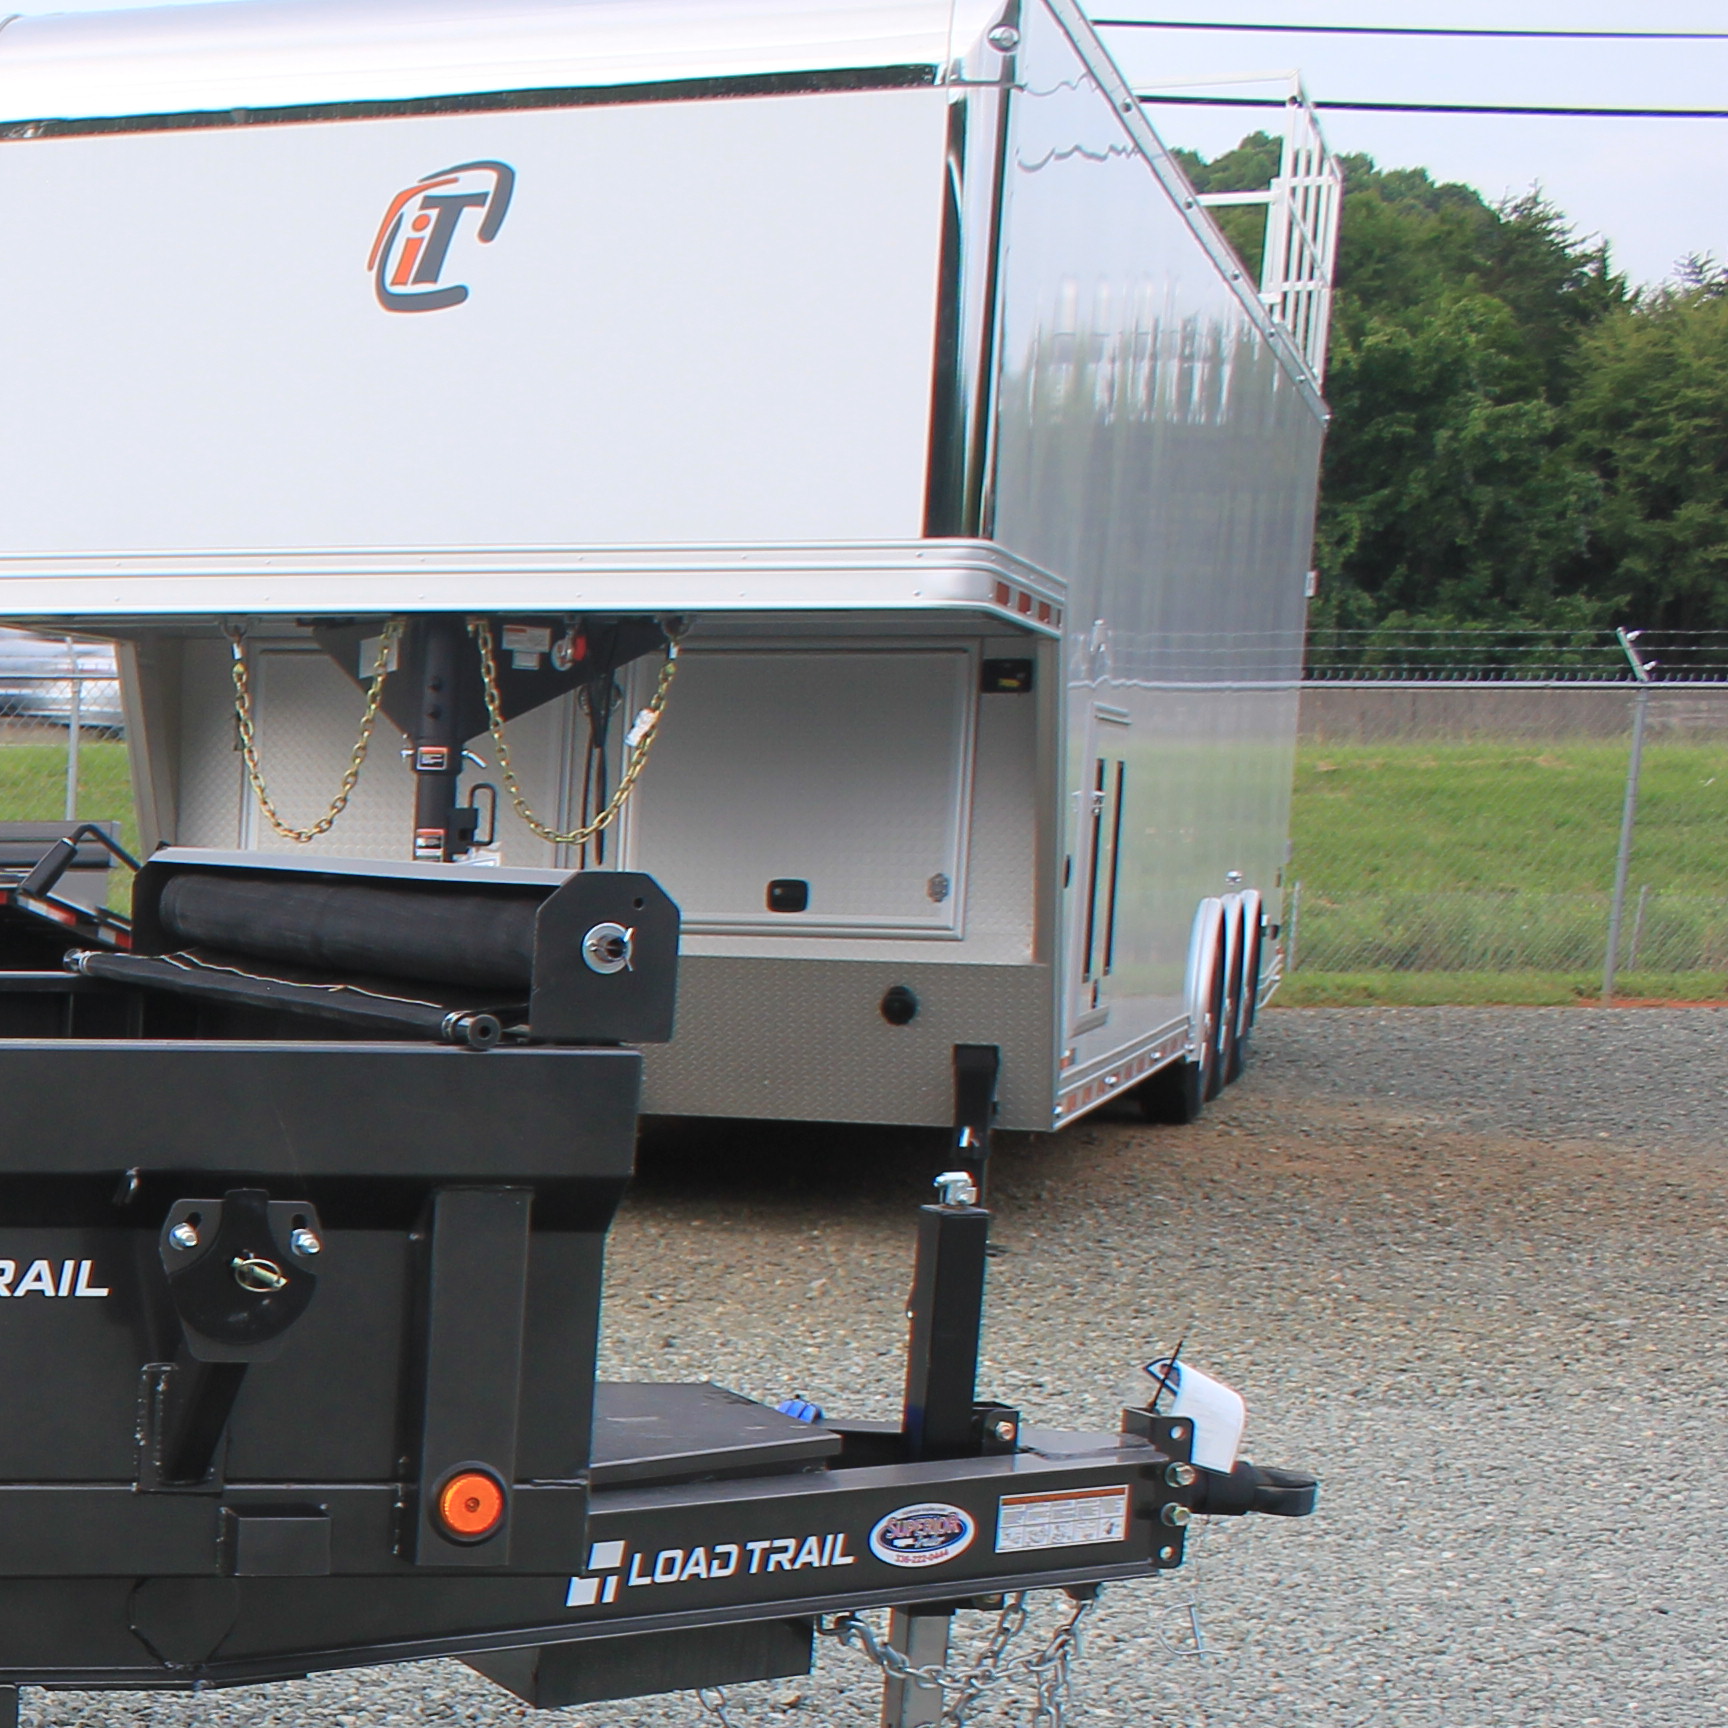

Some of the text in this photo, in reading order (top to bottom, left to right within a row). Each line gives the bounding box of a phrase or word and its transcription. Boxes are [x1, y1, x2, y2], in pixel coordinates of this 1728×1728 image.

[885, 1512, 960, 1539] SUPERIOR
[628, 1533, 856, 1587] LOAD TRAIL
